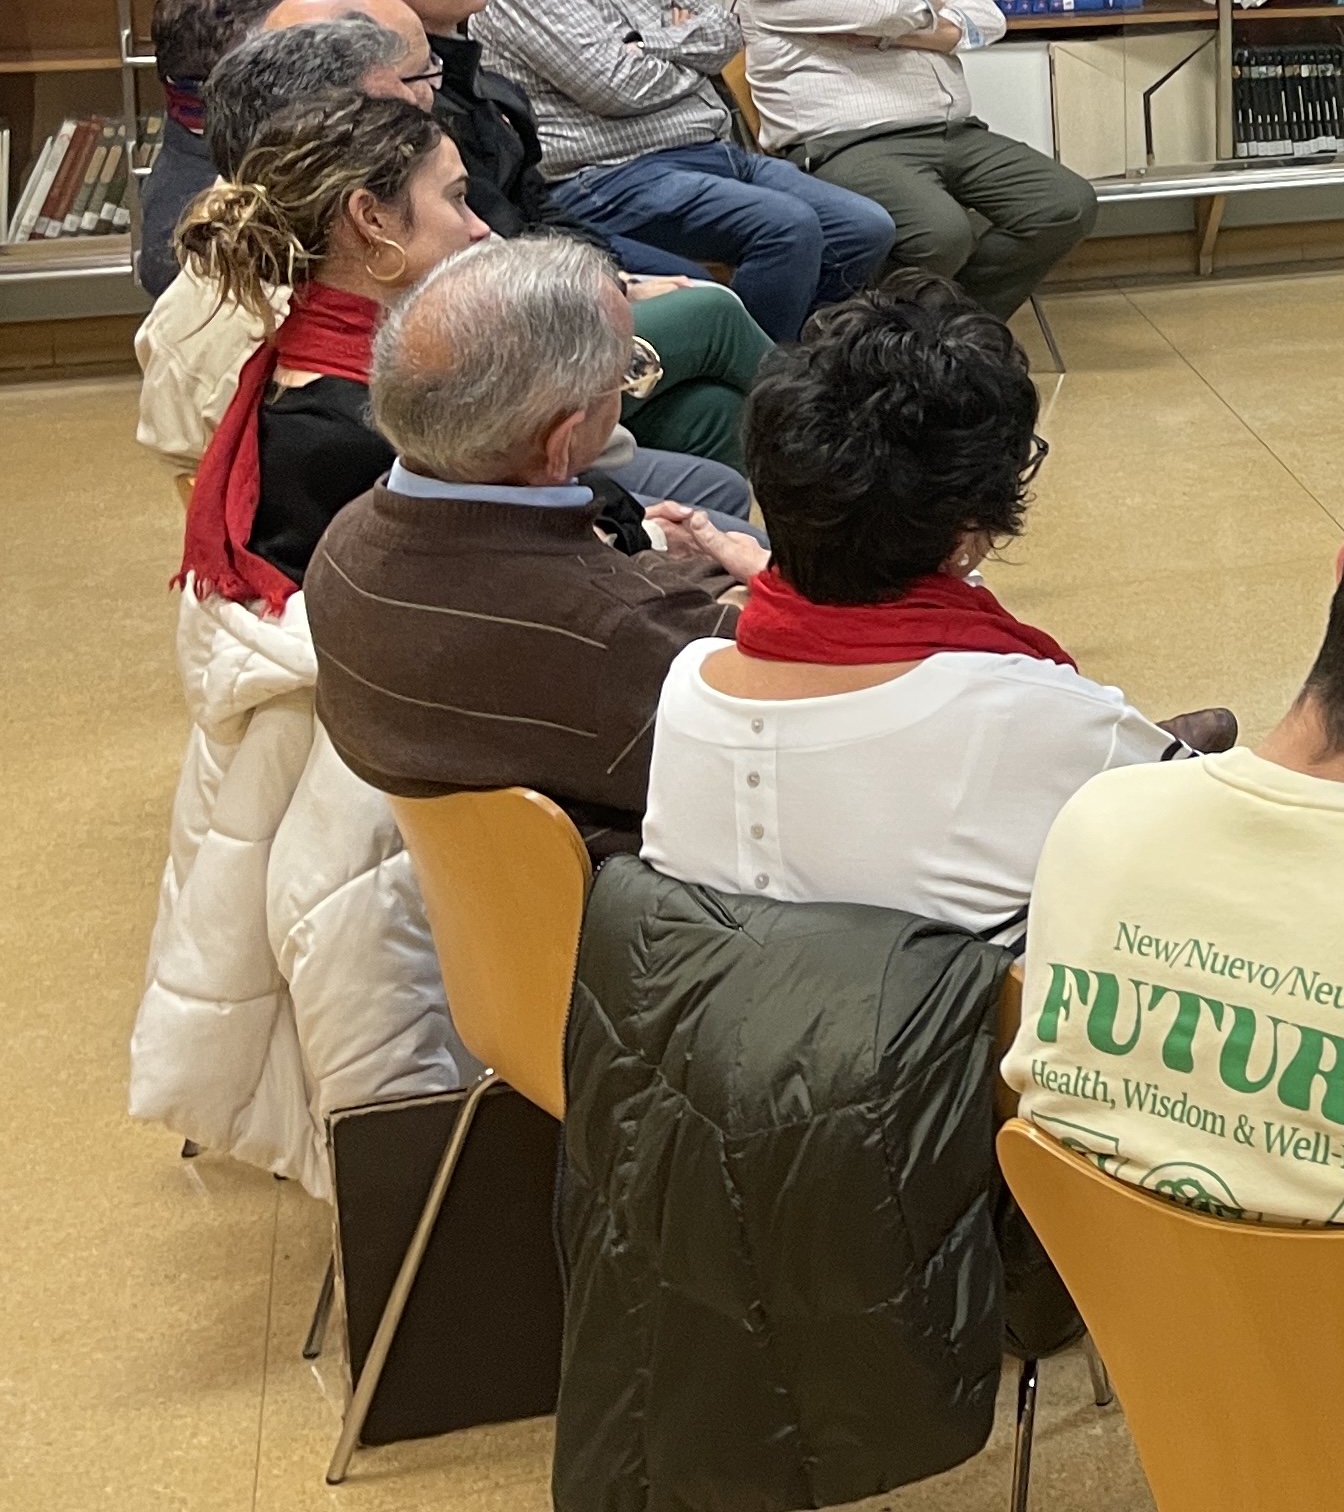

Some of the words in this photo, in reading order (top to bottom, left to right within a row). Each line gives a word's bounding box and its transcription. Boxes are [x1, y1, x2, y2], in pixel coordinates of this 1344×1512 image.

[1031, 1058, 1116, 1111] Health,
[1122, 1077, 1227, 1139] Wisdom
[1232, 1113, 1256, 1149] &
